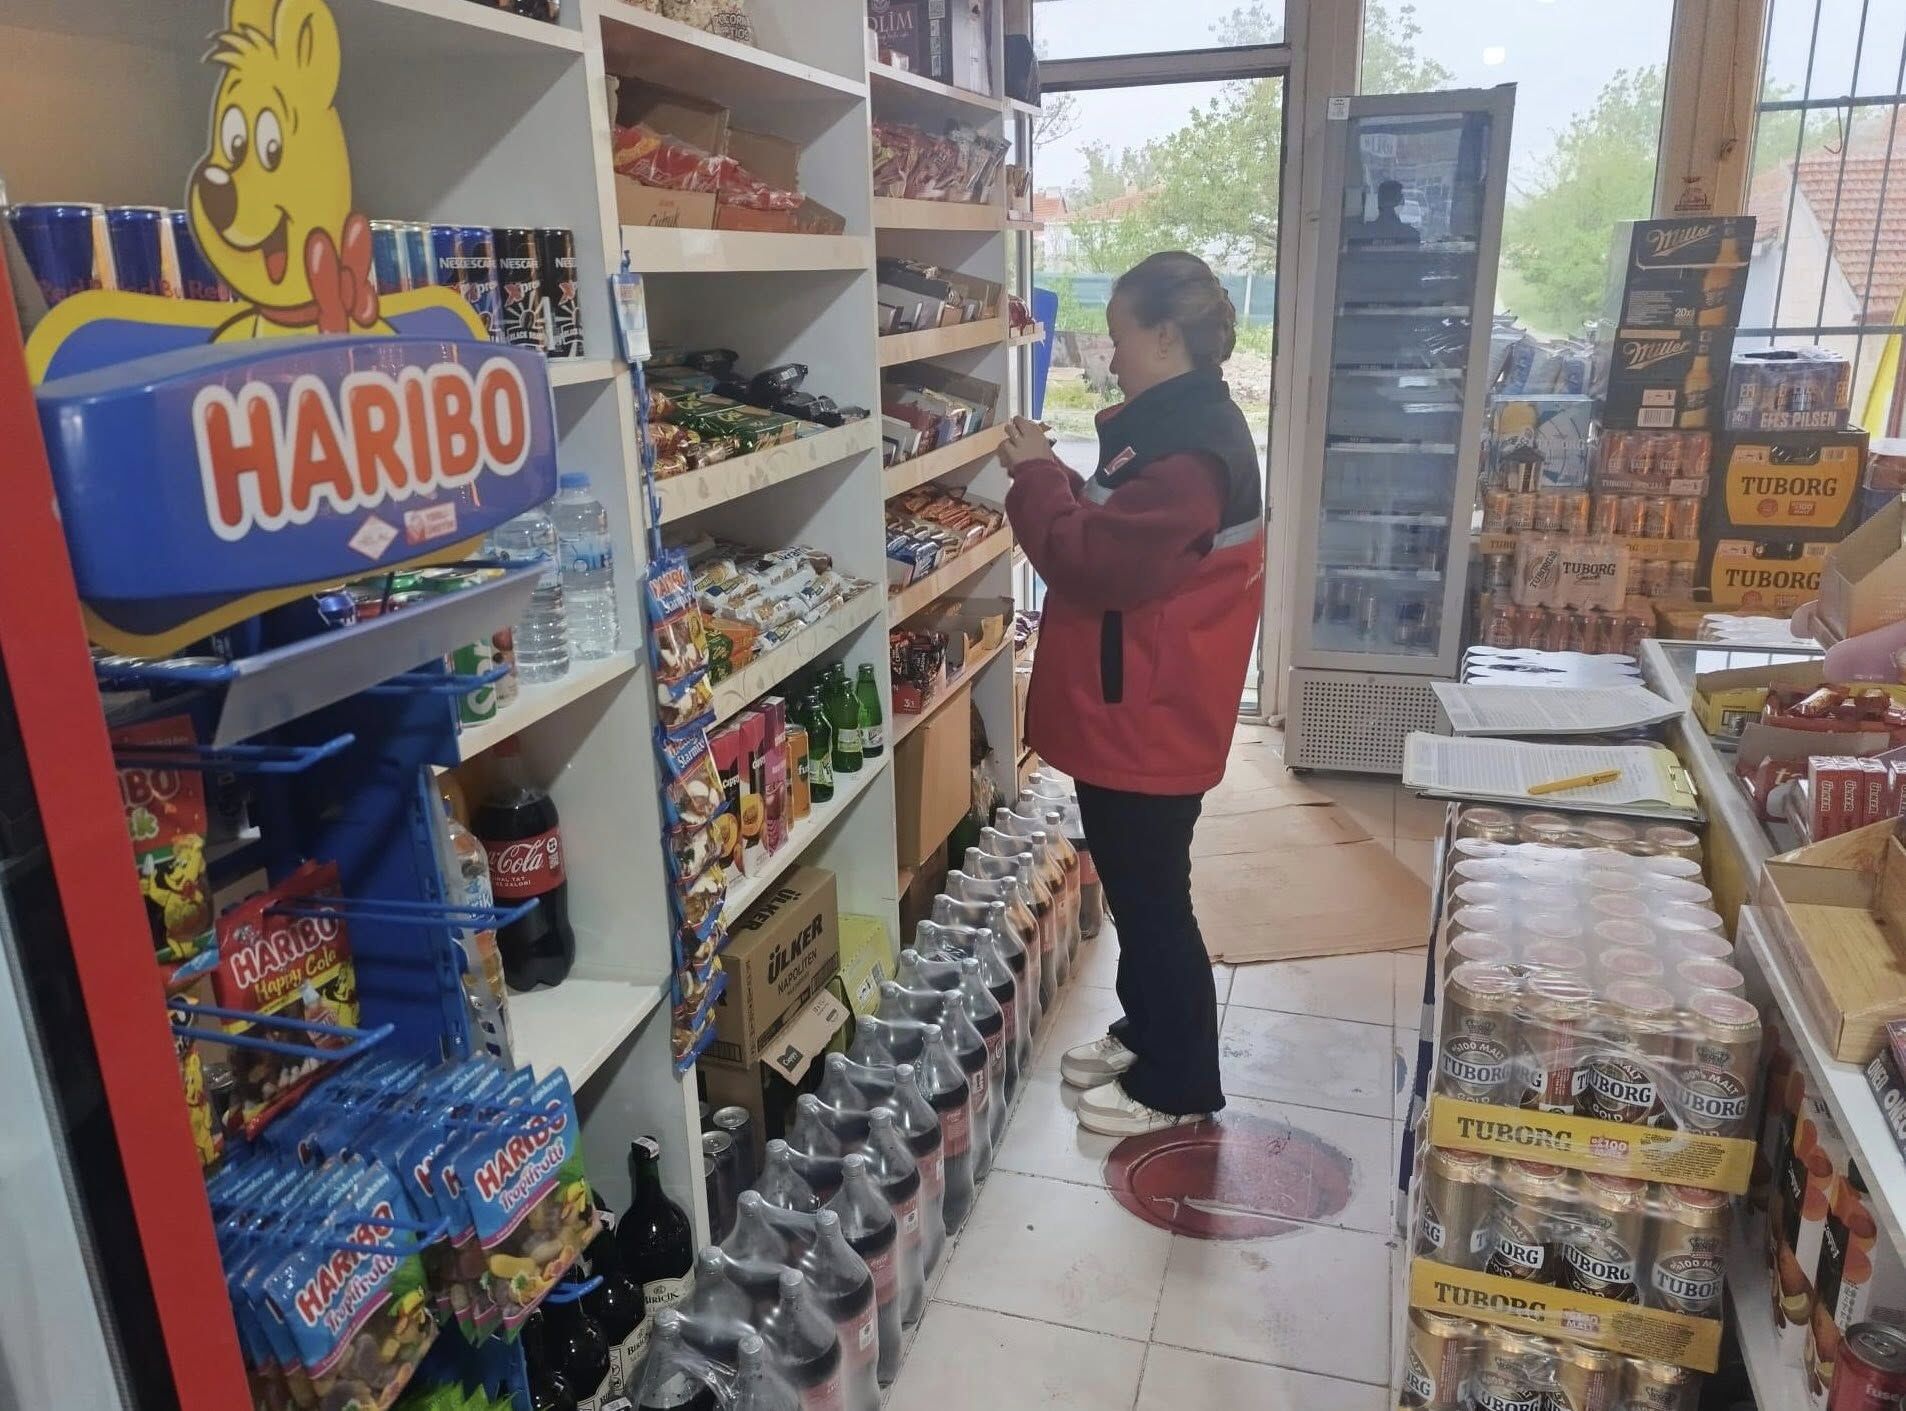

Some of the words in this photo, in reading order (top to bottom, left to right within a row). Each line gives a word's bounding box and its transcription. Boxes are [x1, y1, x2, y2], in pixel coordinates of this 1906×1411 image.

[1648, 225, 1715, 256] Miller
[1624, 340, 1692, 368] Miller
[1792, 410, 1837, 428] PILSEN
[197, 360, 529, 538] HARIBO
[1741, 475, 1838, 497] TUBORG
[1563, 561, 1617, 576] TUBORG
[1726, 568, 1822, 591] TUBORG
[230, 906, 339, 990] HARIBO
[767, 913, 824, 985] ÜLKER
[255, 966, 301, 1001] Happy
[305, 947, 337, 977] Cola
[1478, 1043, 1505, 1060] MALT
[1442, 1054, 1510, 1083] TUBORG
[1589, 1071, 1652, 1103] UBORG
[1708, 1074, 1740, 1096] MALT
[1592, 1103, 1624, 1122] GOLD
[1457, 1116, 1572, 1151] TUBORG
[475, 1099, 568, 1203] HARIBO
[500, 1136, 566, 1213] Tropifrutti
[295, 1201, 395, 1327] HARIBO
[1502, 1239, 1539, 1265] ORG
[1566, 1245, 1630, 1281] UBORG
[324, 1250, 398, 1337] Tropifrutti
[1434, 1281, 1546, 1322] TUBORG
